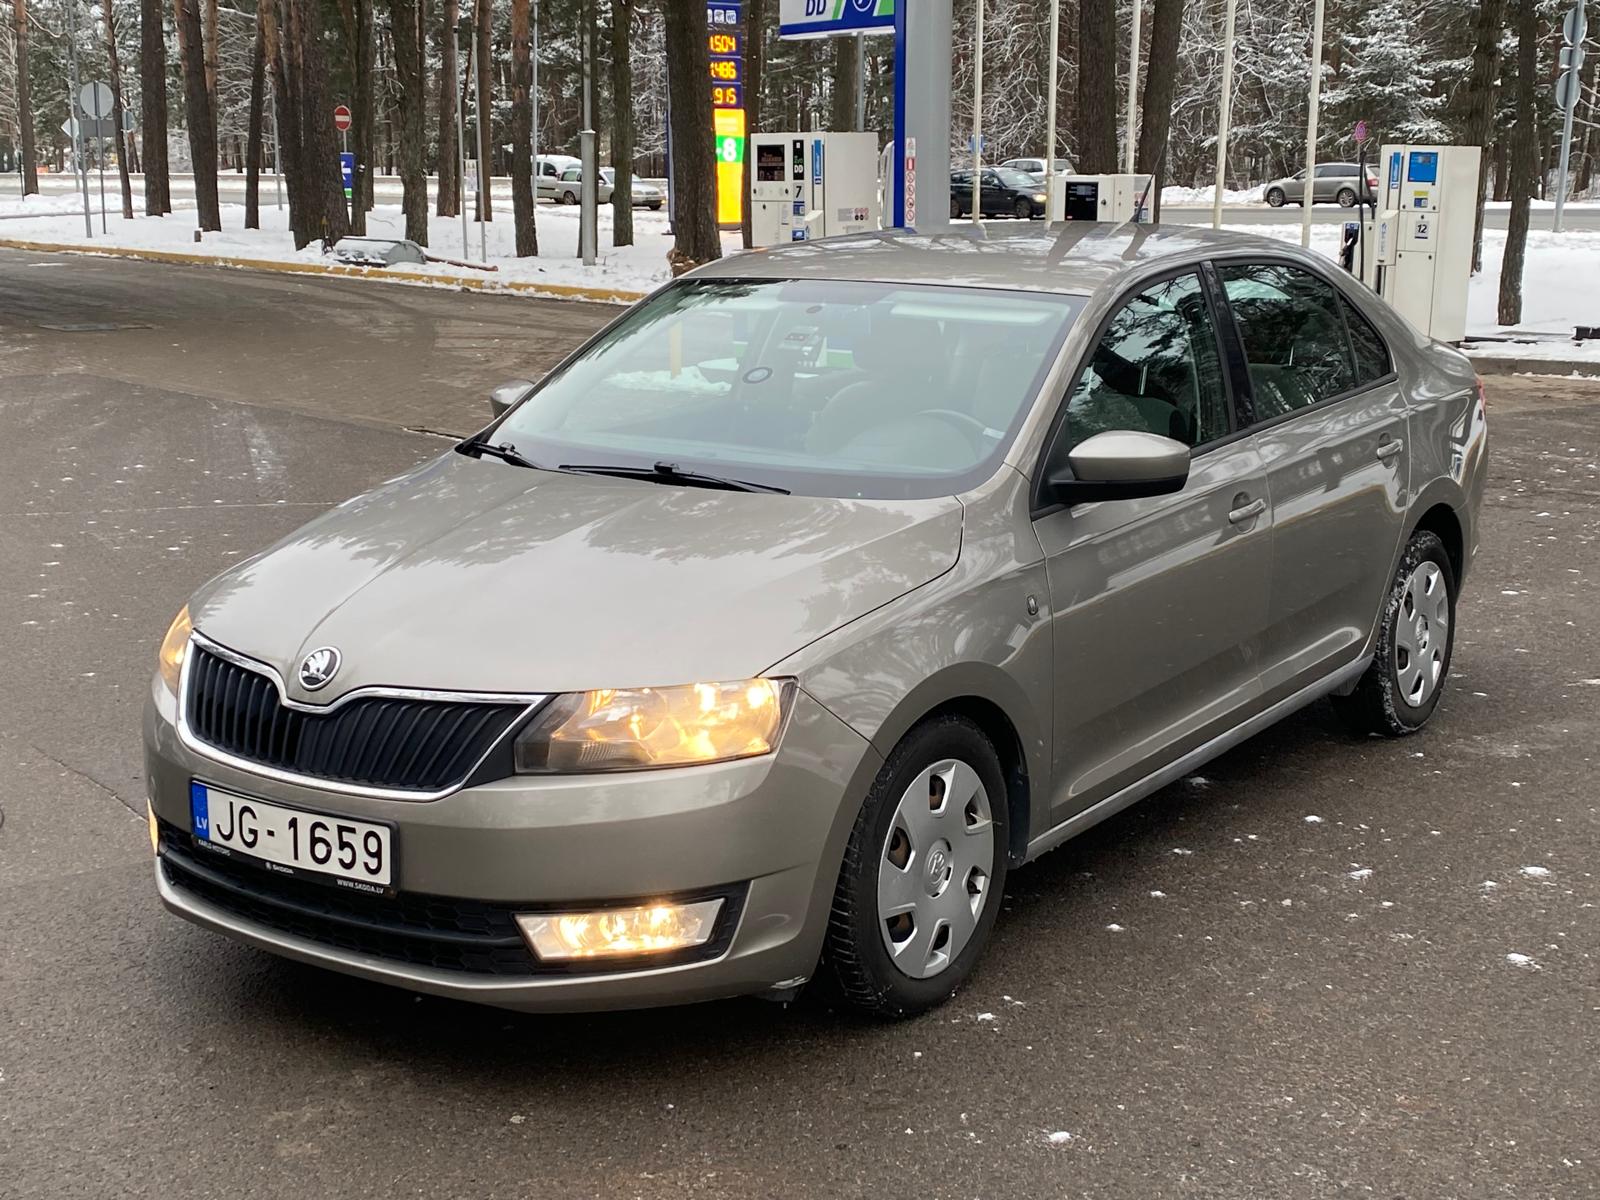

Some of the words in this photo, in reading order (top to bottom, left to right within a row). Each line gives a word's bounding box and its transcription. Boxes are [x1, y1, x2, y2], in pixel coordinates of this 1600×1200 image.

[796, 186, 802, 198] 7
[1417, 224, 1427, 233] 12
[196, 815, 208, 830] LV
[216, 801, 383, 875] JG-1659
[336, 879, 384, 894] WWW.SKODA.LV
